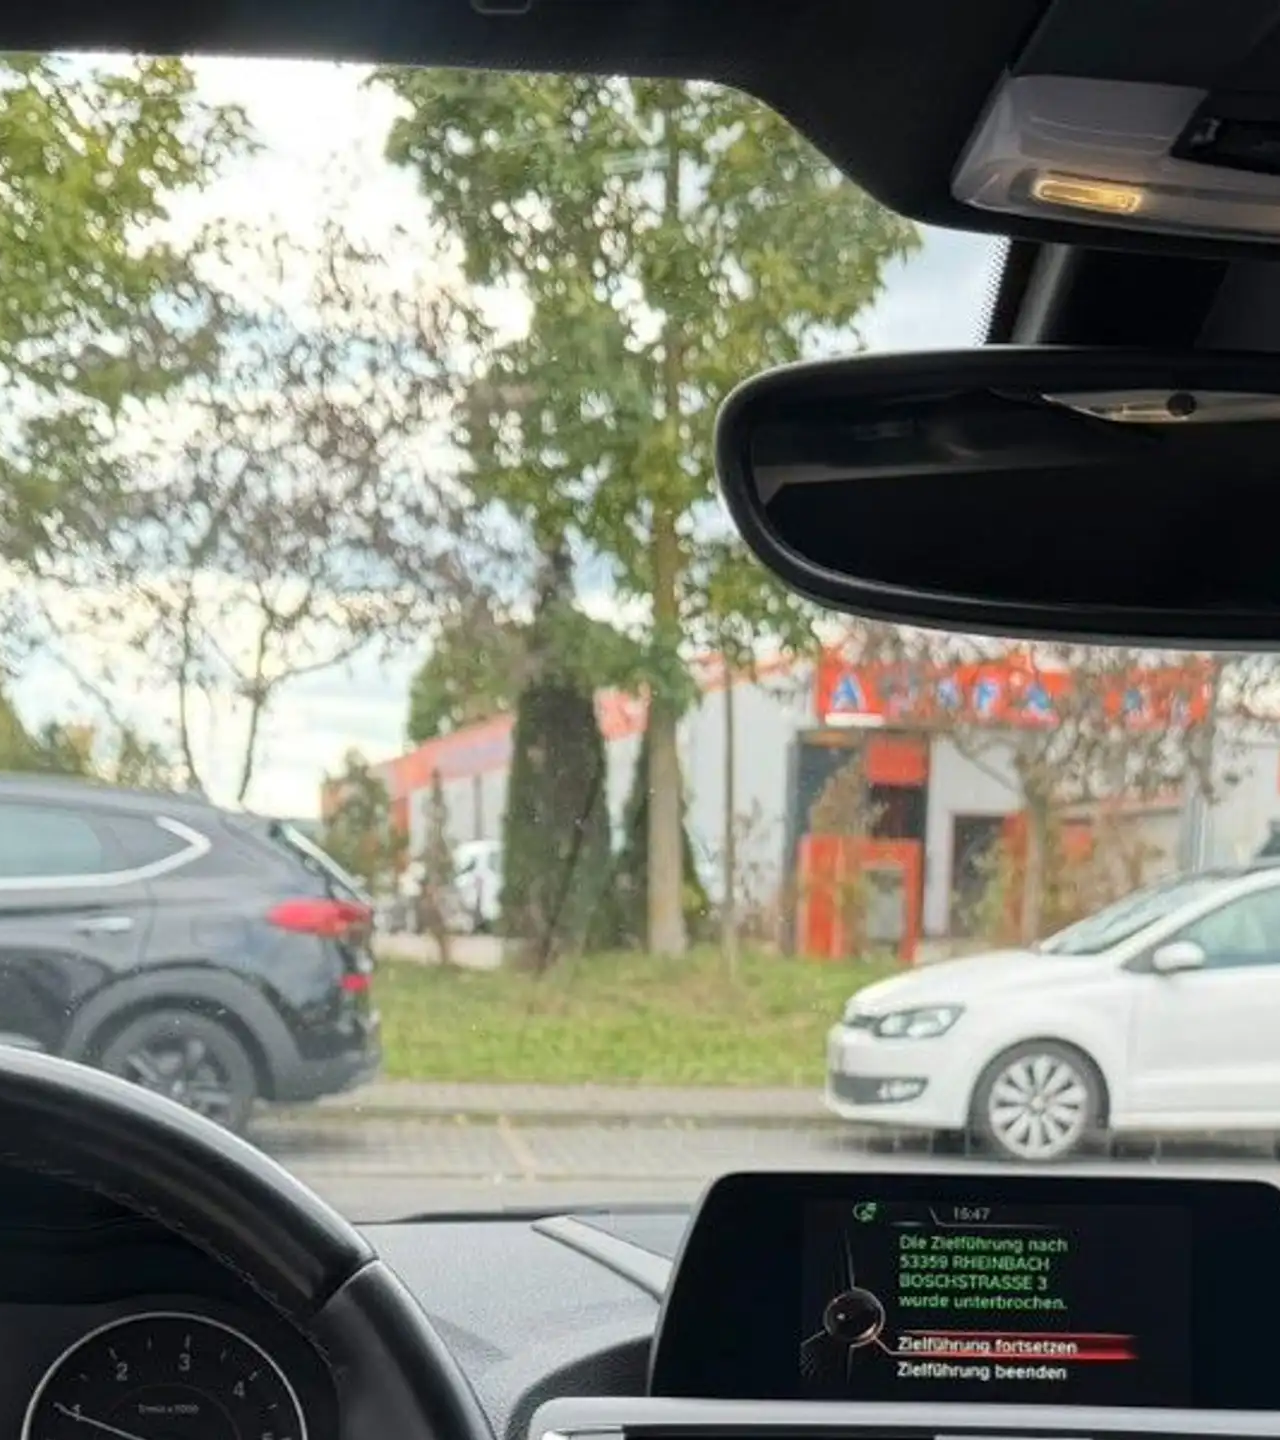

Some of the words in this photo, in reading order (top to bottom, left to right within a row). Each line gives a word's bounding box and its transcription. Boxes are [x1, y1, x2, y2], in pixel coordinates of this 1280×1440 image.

[899, 1234, 927, 1250] Die
[931, 1235, 1024, 1254] Zielführung
[1028, 1237, 1069, 1252] nach
[952, 1255, 1050, 1272] RHEINBACH
[899, 1272, 1033, 1290] BOSCHSTRASSE
[1036, 1276, 1048, 1291] 3
[898, 1293, 949, 1308] wurde
[953, 1294, 1068, 1310] unterbrochen.
[897, 1335, 991, 1355] Zielführung
[994, 1337, 1078, 1355] fortsetzen
[178, 1352, 191, 1372] 3
[896, 1361, 991, 1381] Zielführung
[994, 1363, 1067, 1380] beenden
[115, 1363, 128, 1382] 2
[232, 1380, 246, 1398] 4
